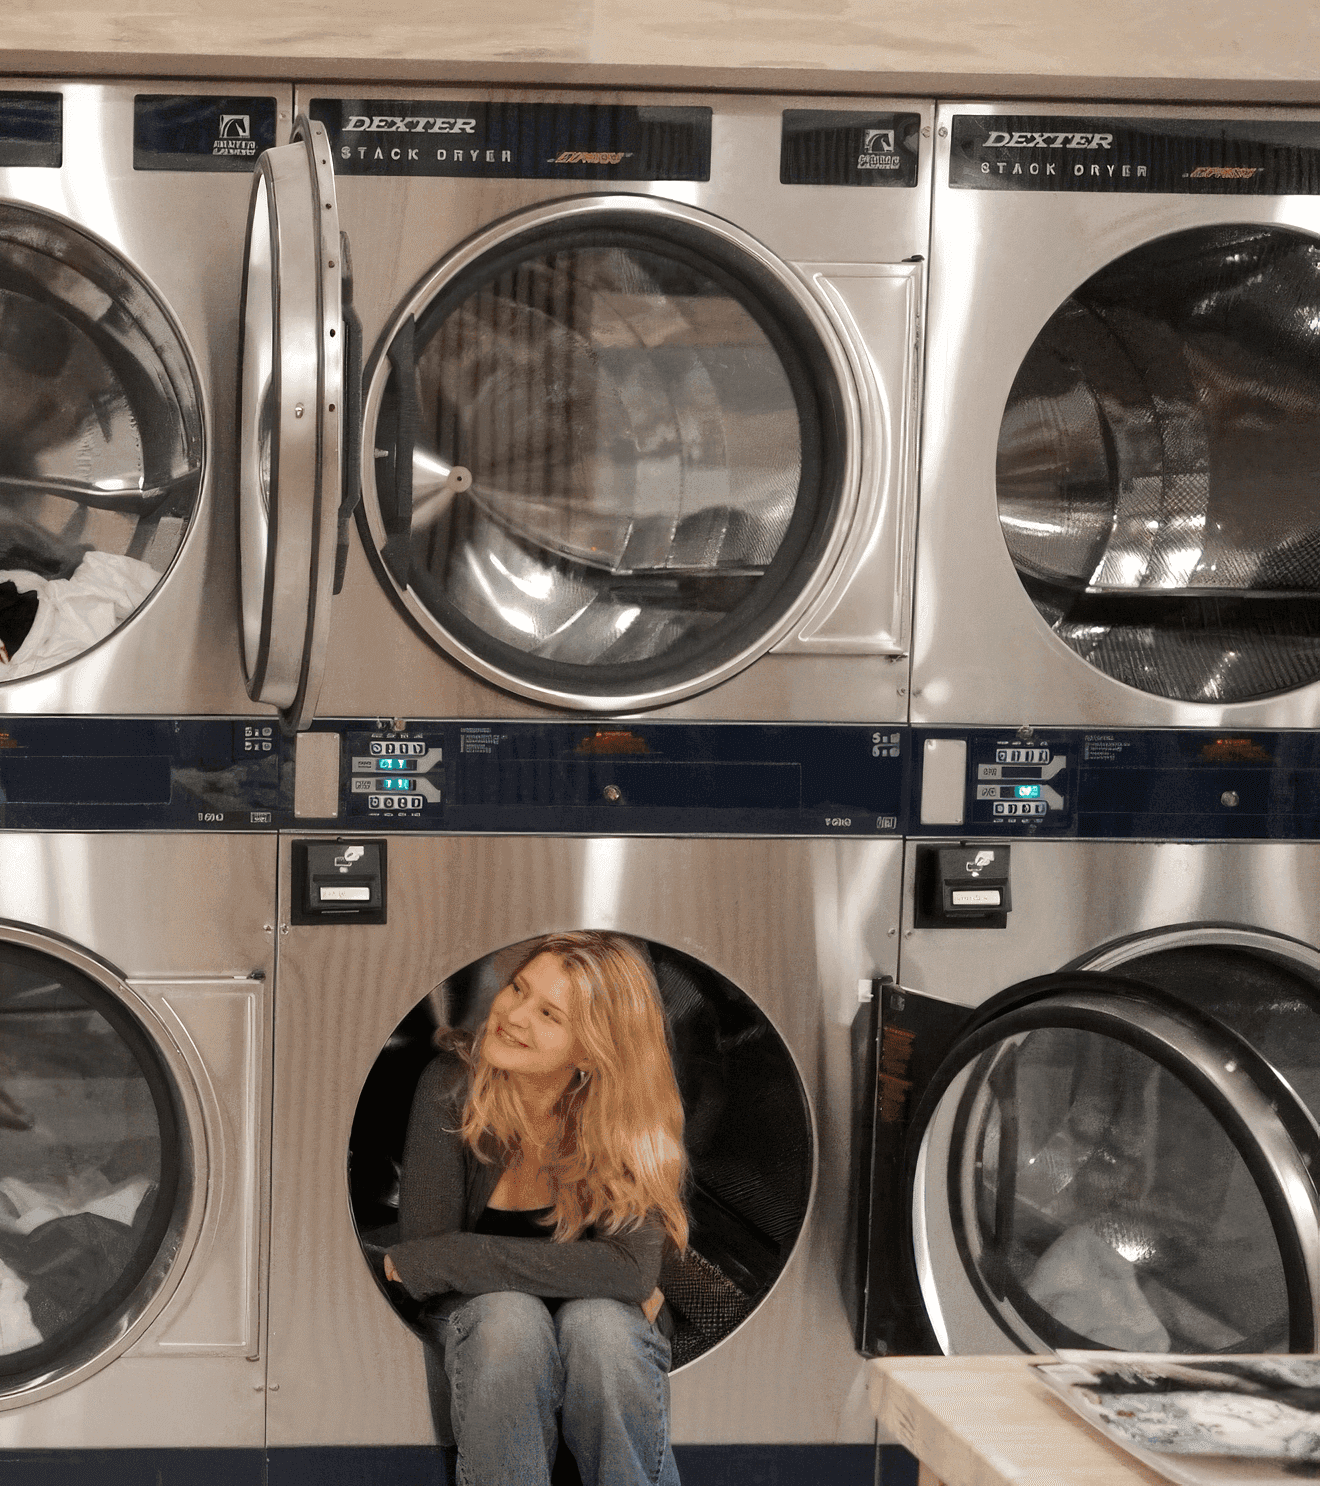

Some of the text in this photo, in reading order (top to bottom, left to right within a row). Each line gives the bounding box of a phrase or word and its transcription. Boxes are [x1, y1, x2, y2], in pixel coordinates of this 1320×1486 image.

[342, 115, 477, 133] DEXTER
[982, 131, 1113, 149] DEXTER
[340, 146, 419, 160] STACK
